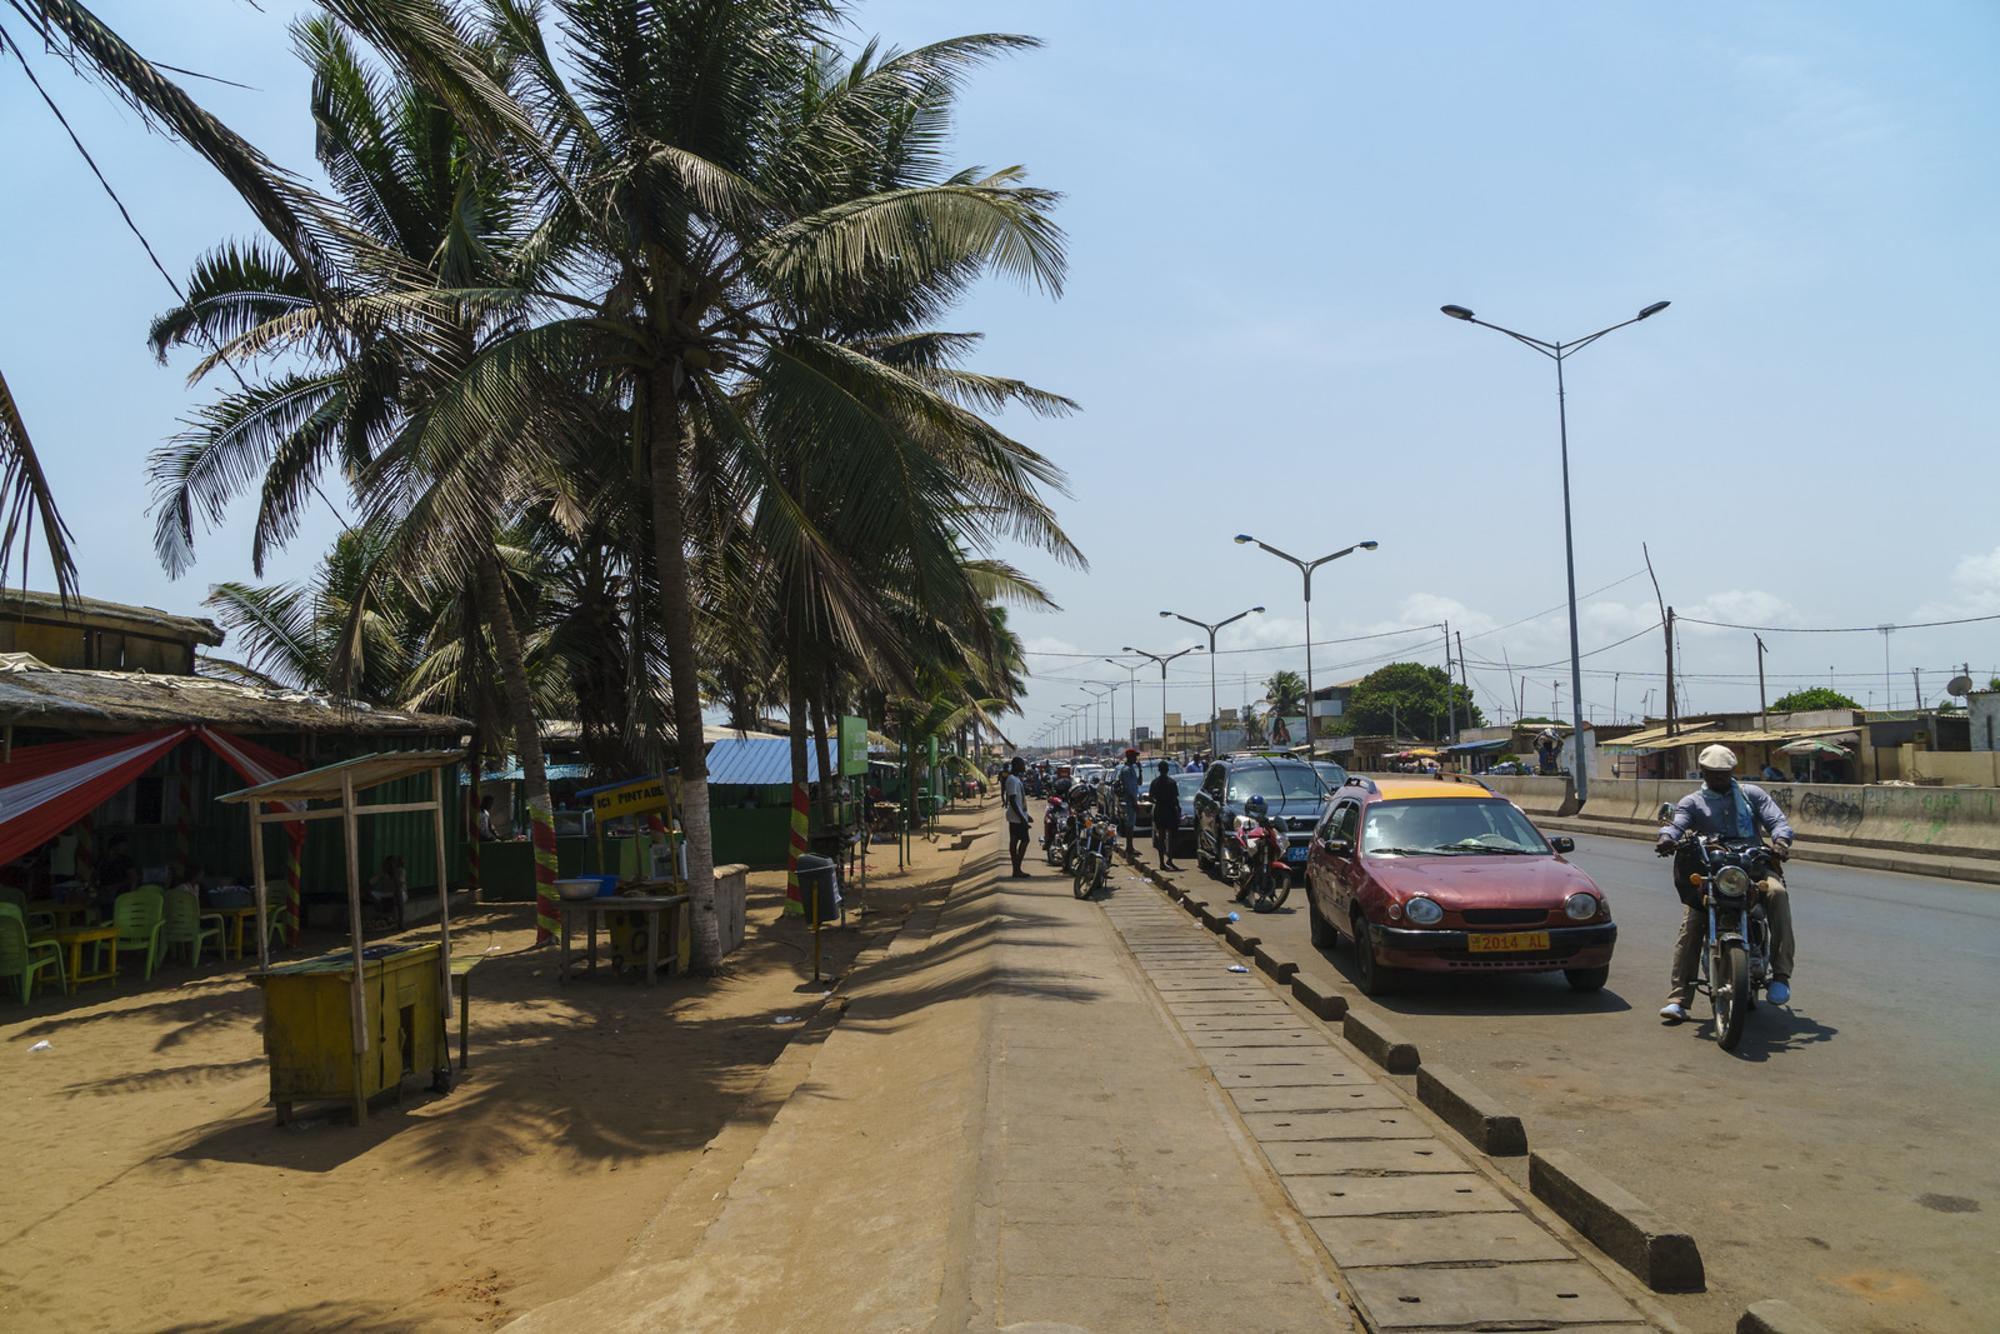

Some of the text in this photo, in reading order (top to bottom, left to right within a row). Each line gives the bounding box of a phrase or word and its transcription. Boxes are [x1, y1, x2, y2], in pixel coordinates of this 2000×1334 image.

[597, 797, 611, 809] ICI
[1482, 935, 1518, 950] 2014
[1528, 934, 1548, 948] AL
